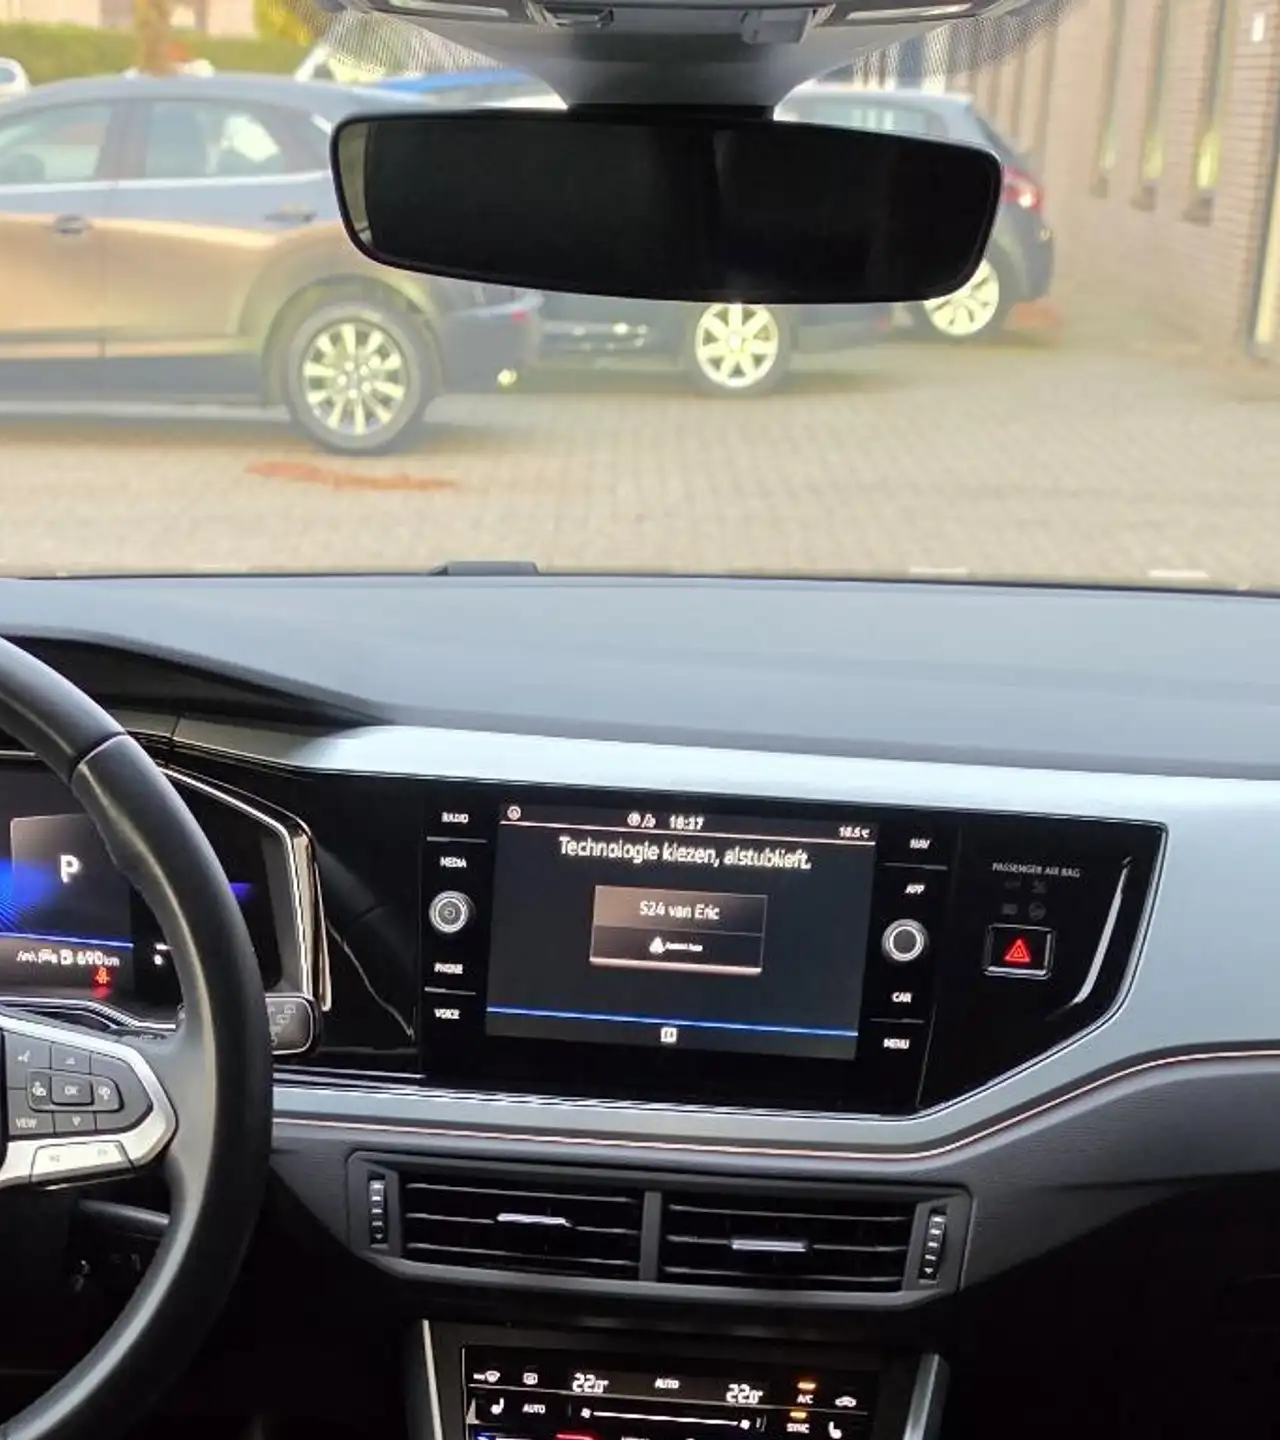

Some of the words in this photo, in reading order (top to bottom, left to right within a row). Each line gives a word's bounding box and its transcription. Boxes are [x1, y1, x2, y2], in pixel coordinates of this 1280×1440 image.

[558, 836, 660, 864] Technologie
[662, 842, 720, 868] kiezen,
[723, 845, 812, 870] alstublieft.
[60, 854, 81, 883] P
[440, 856, 467, 868] MEDIA
[992, 862, 1042, 875] PASSENGER
[904, 883, 926, 895] APP
[639, 900, 665, 917] S24
[668, 904, 692, 919] van
[694, 903, 720, 920] Eric
[891, 991, 913, 1004] CAR
[882, 1037, 910, 1050] MENU
[654, 1378, 680, 1389] AUTO
[522, 1404, 546, 1415] AUTO
